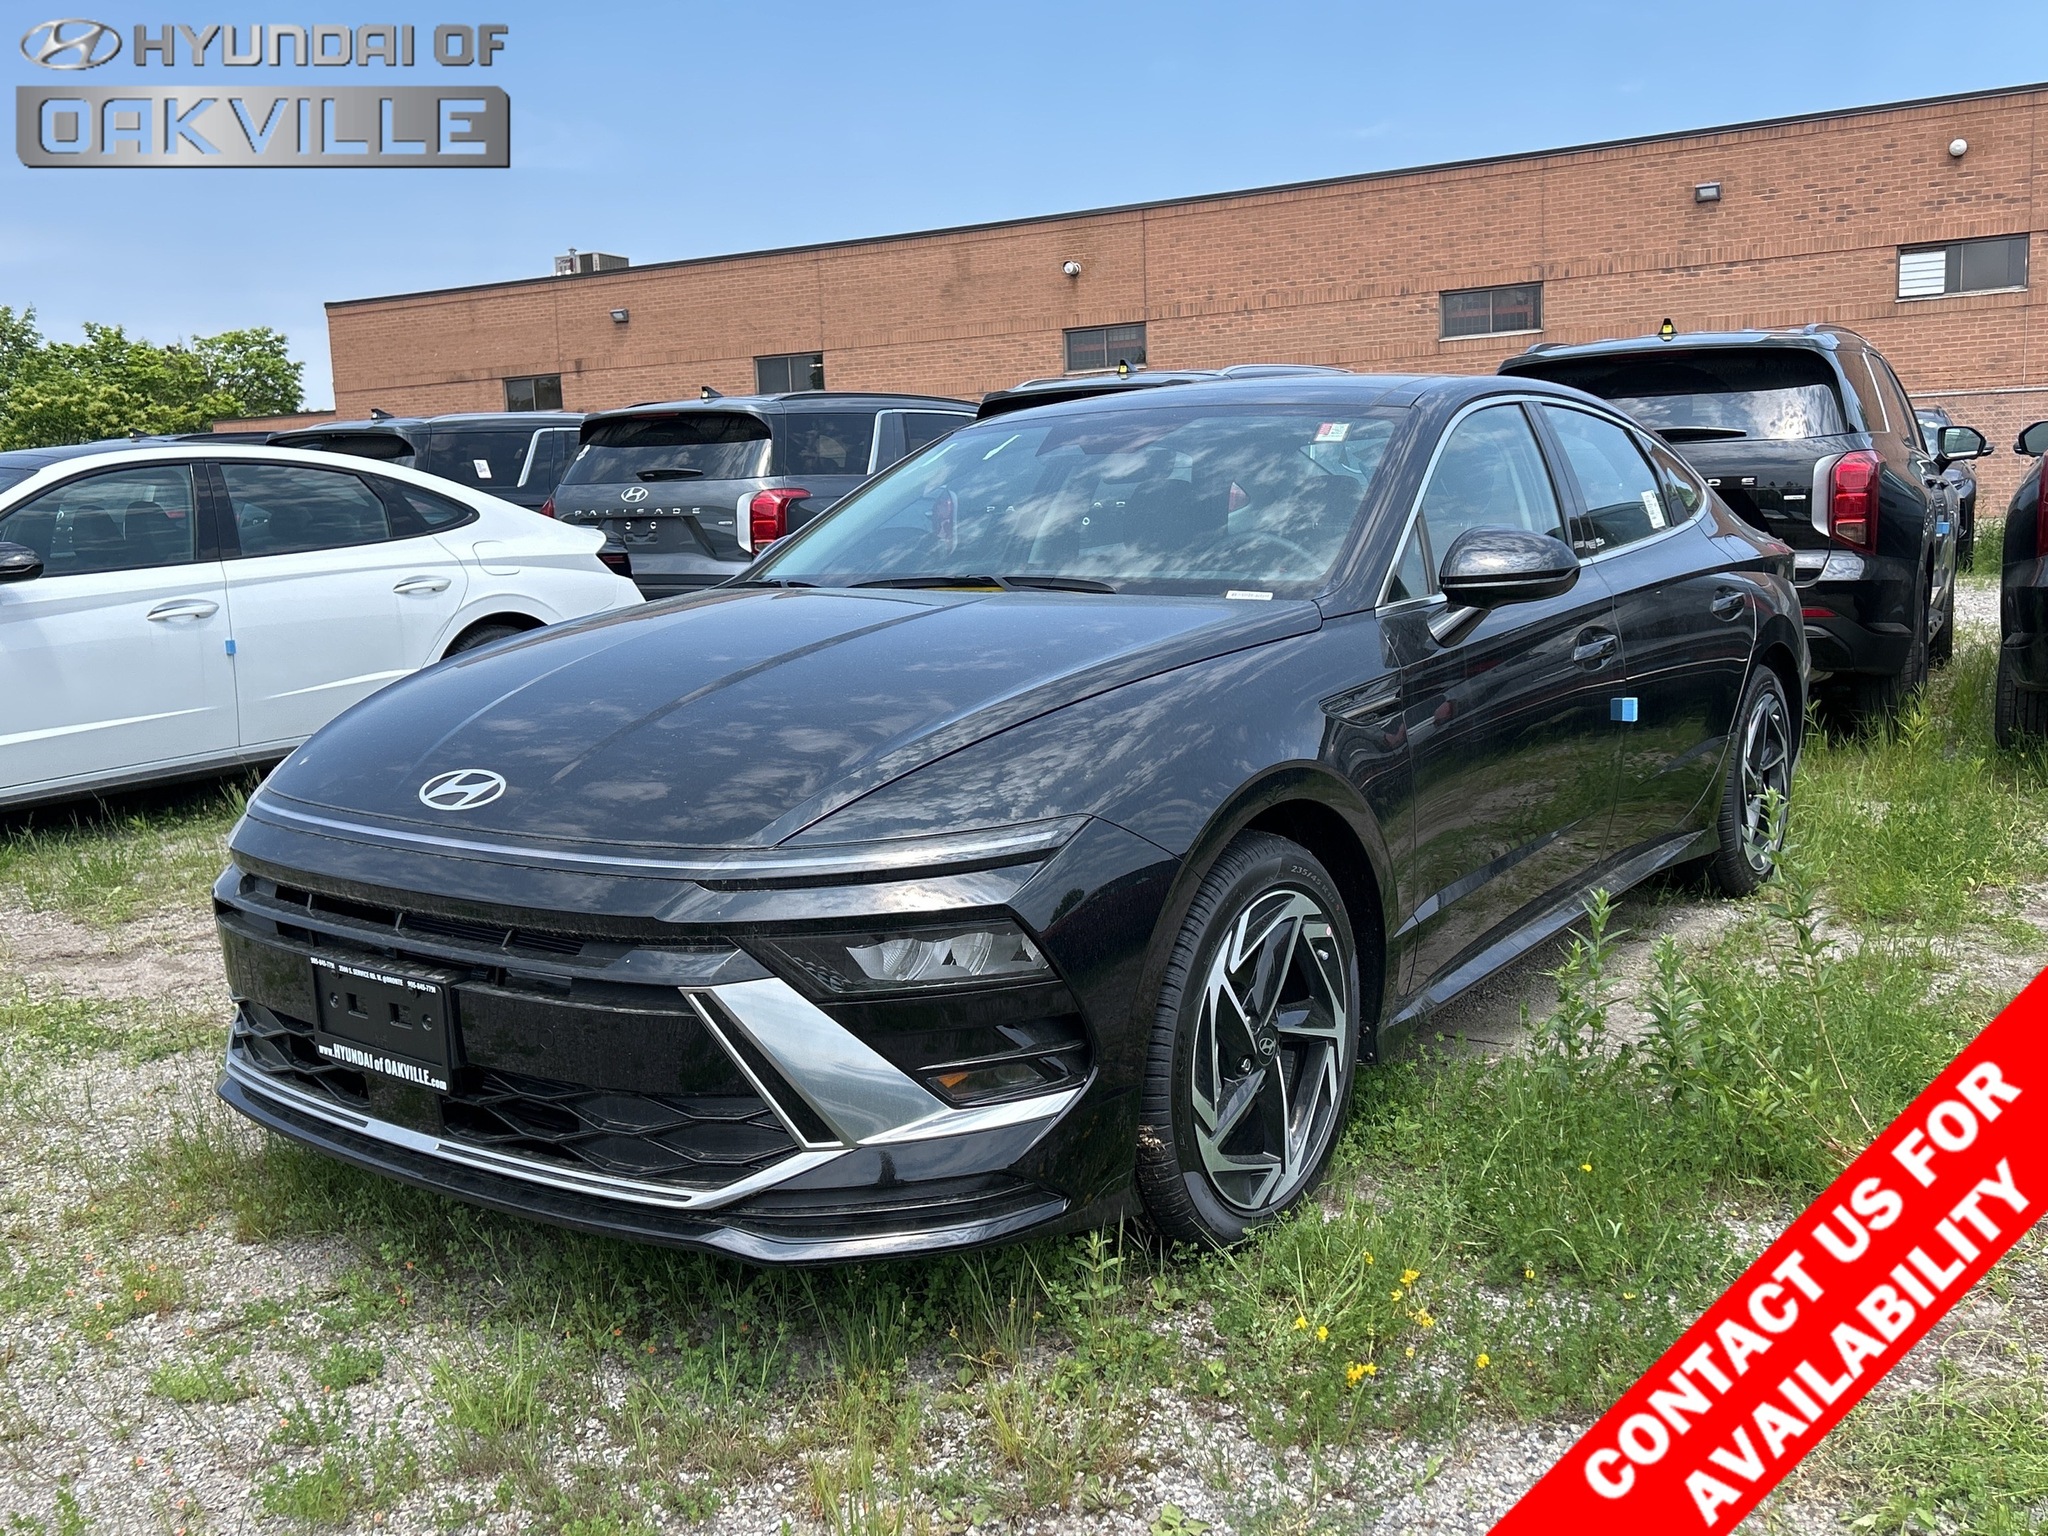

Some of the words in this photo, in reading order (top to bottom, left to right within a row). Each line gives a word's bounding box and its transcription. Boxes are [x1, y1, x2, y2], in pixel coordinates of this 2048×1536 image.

[574, 507, 700, 516] PALISADE
[318, 1043, 374, 1070] www.HYUNDAI
[373, 1057, 385, 1073] of
[384, 1058, 448, 1091] OAKVILLE.com
